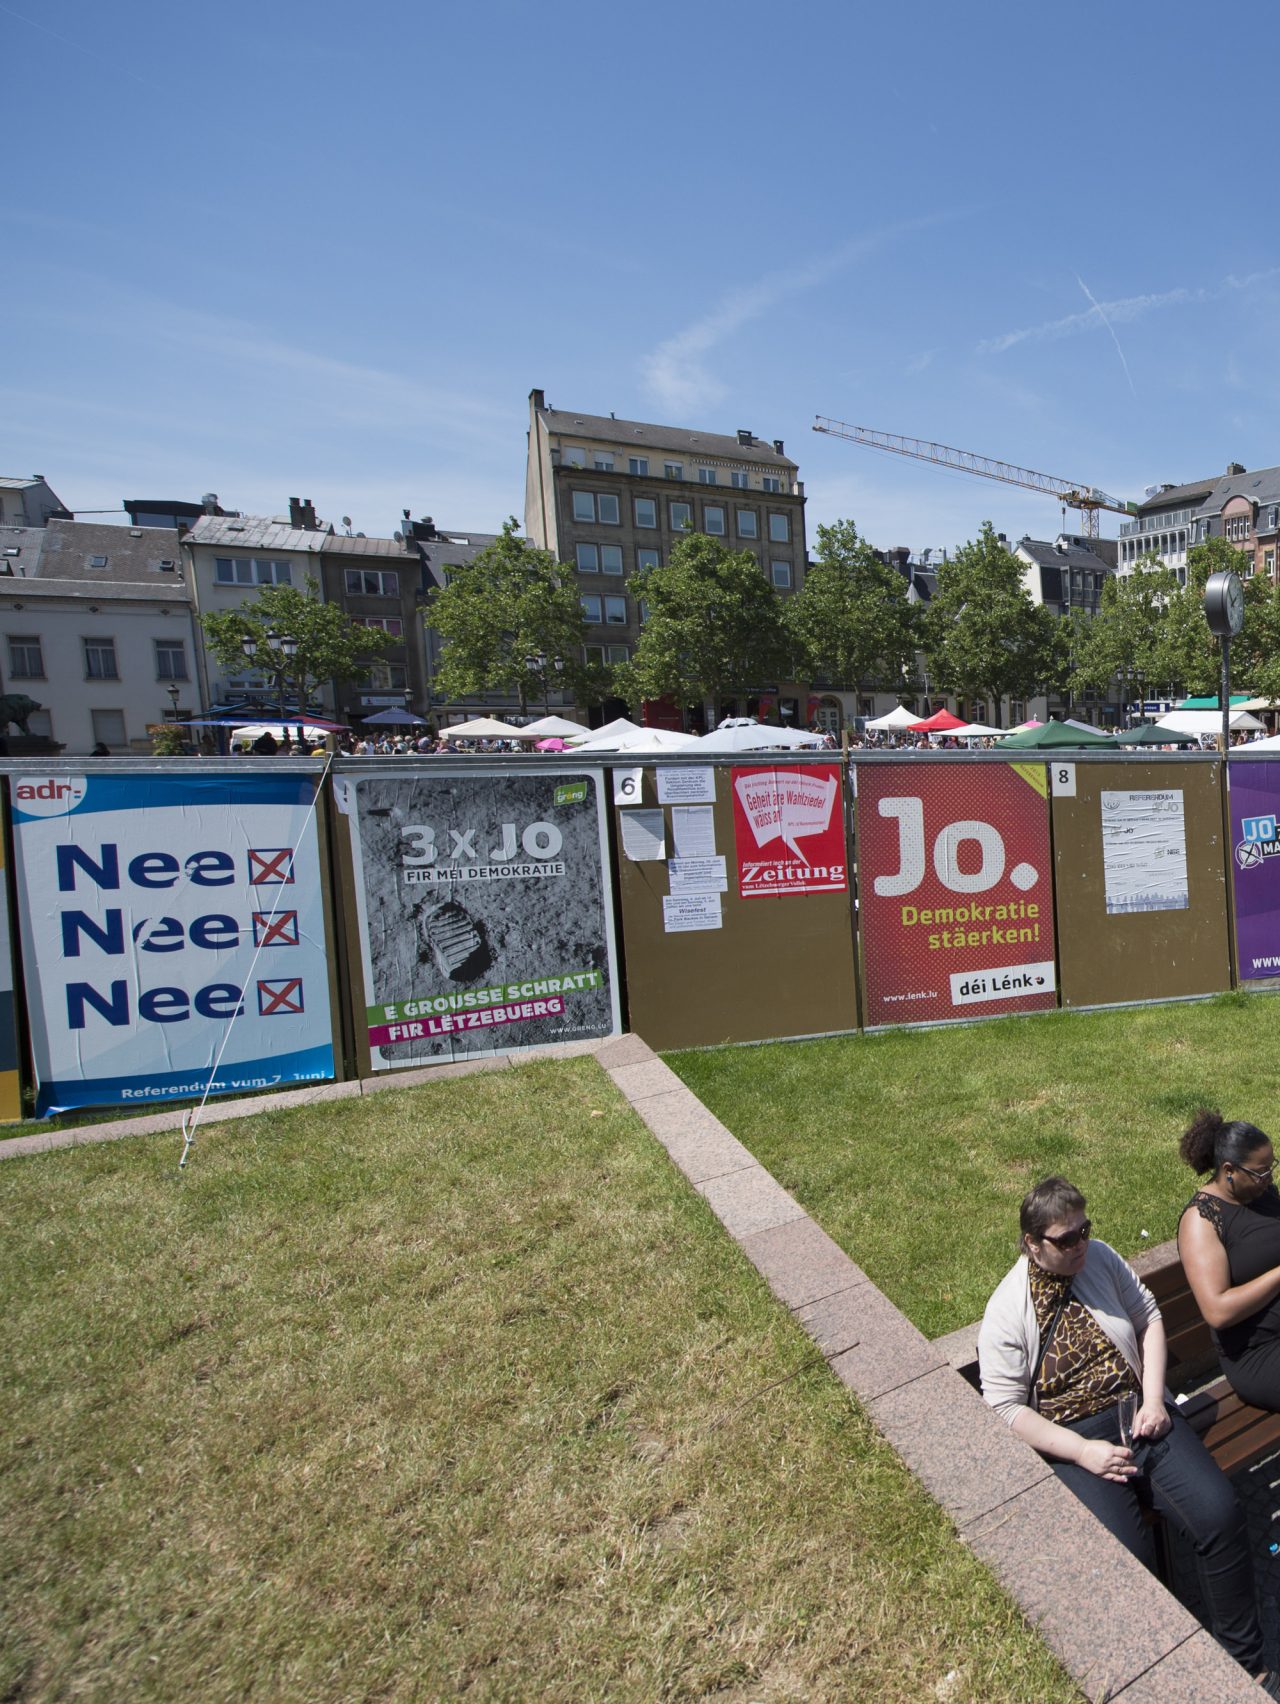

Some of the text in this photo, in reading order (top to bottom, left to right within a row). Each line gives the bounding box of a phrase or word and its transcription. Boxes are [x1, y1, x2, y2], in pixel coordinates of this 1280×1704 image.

[621, 777, 635, 796] 6
[1058, 769, 1069, 784] 8
[746, 791, 771, 811] Geheit
[786, 789, 826, 809] Wahlziedel
[1246, 819, 1273, 841] JO
[401, 824, 438, 866] 3
[489, 821, 563, 862] JO
[874, 796, 1039, 897] Jo.
[56, 843, 235, 892] Nee
[407, 871, 432, 882] FIR
[468, 863, 564, 879] DEMOKRATIE
[741, 865, 845, 883] Zeitung
[901, 900, 1041, 926] Demokratie
[61, 908, 240, 958] Nee
[928, 923, 1040, 949] stäerken!
[384, 972, 598, 1020] E GROUSSE SCHRATT
[883, 990, 938, 1003] www.lenk.lu
[959, 973, 1033, 996] déi Lénk
[66, 979, 245, 1030] Nee
[388, 998, 562, 1041] FIR LËTZEBUERG
[121, 1081, 226, 1099] Referendum
[231, 1077, 267, 1088] vum
